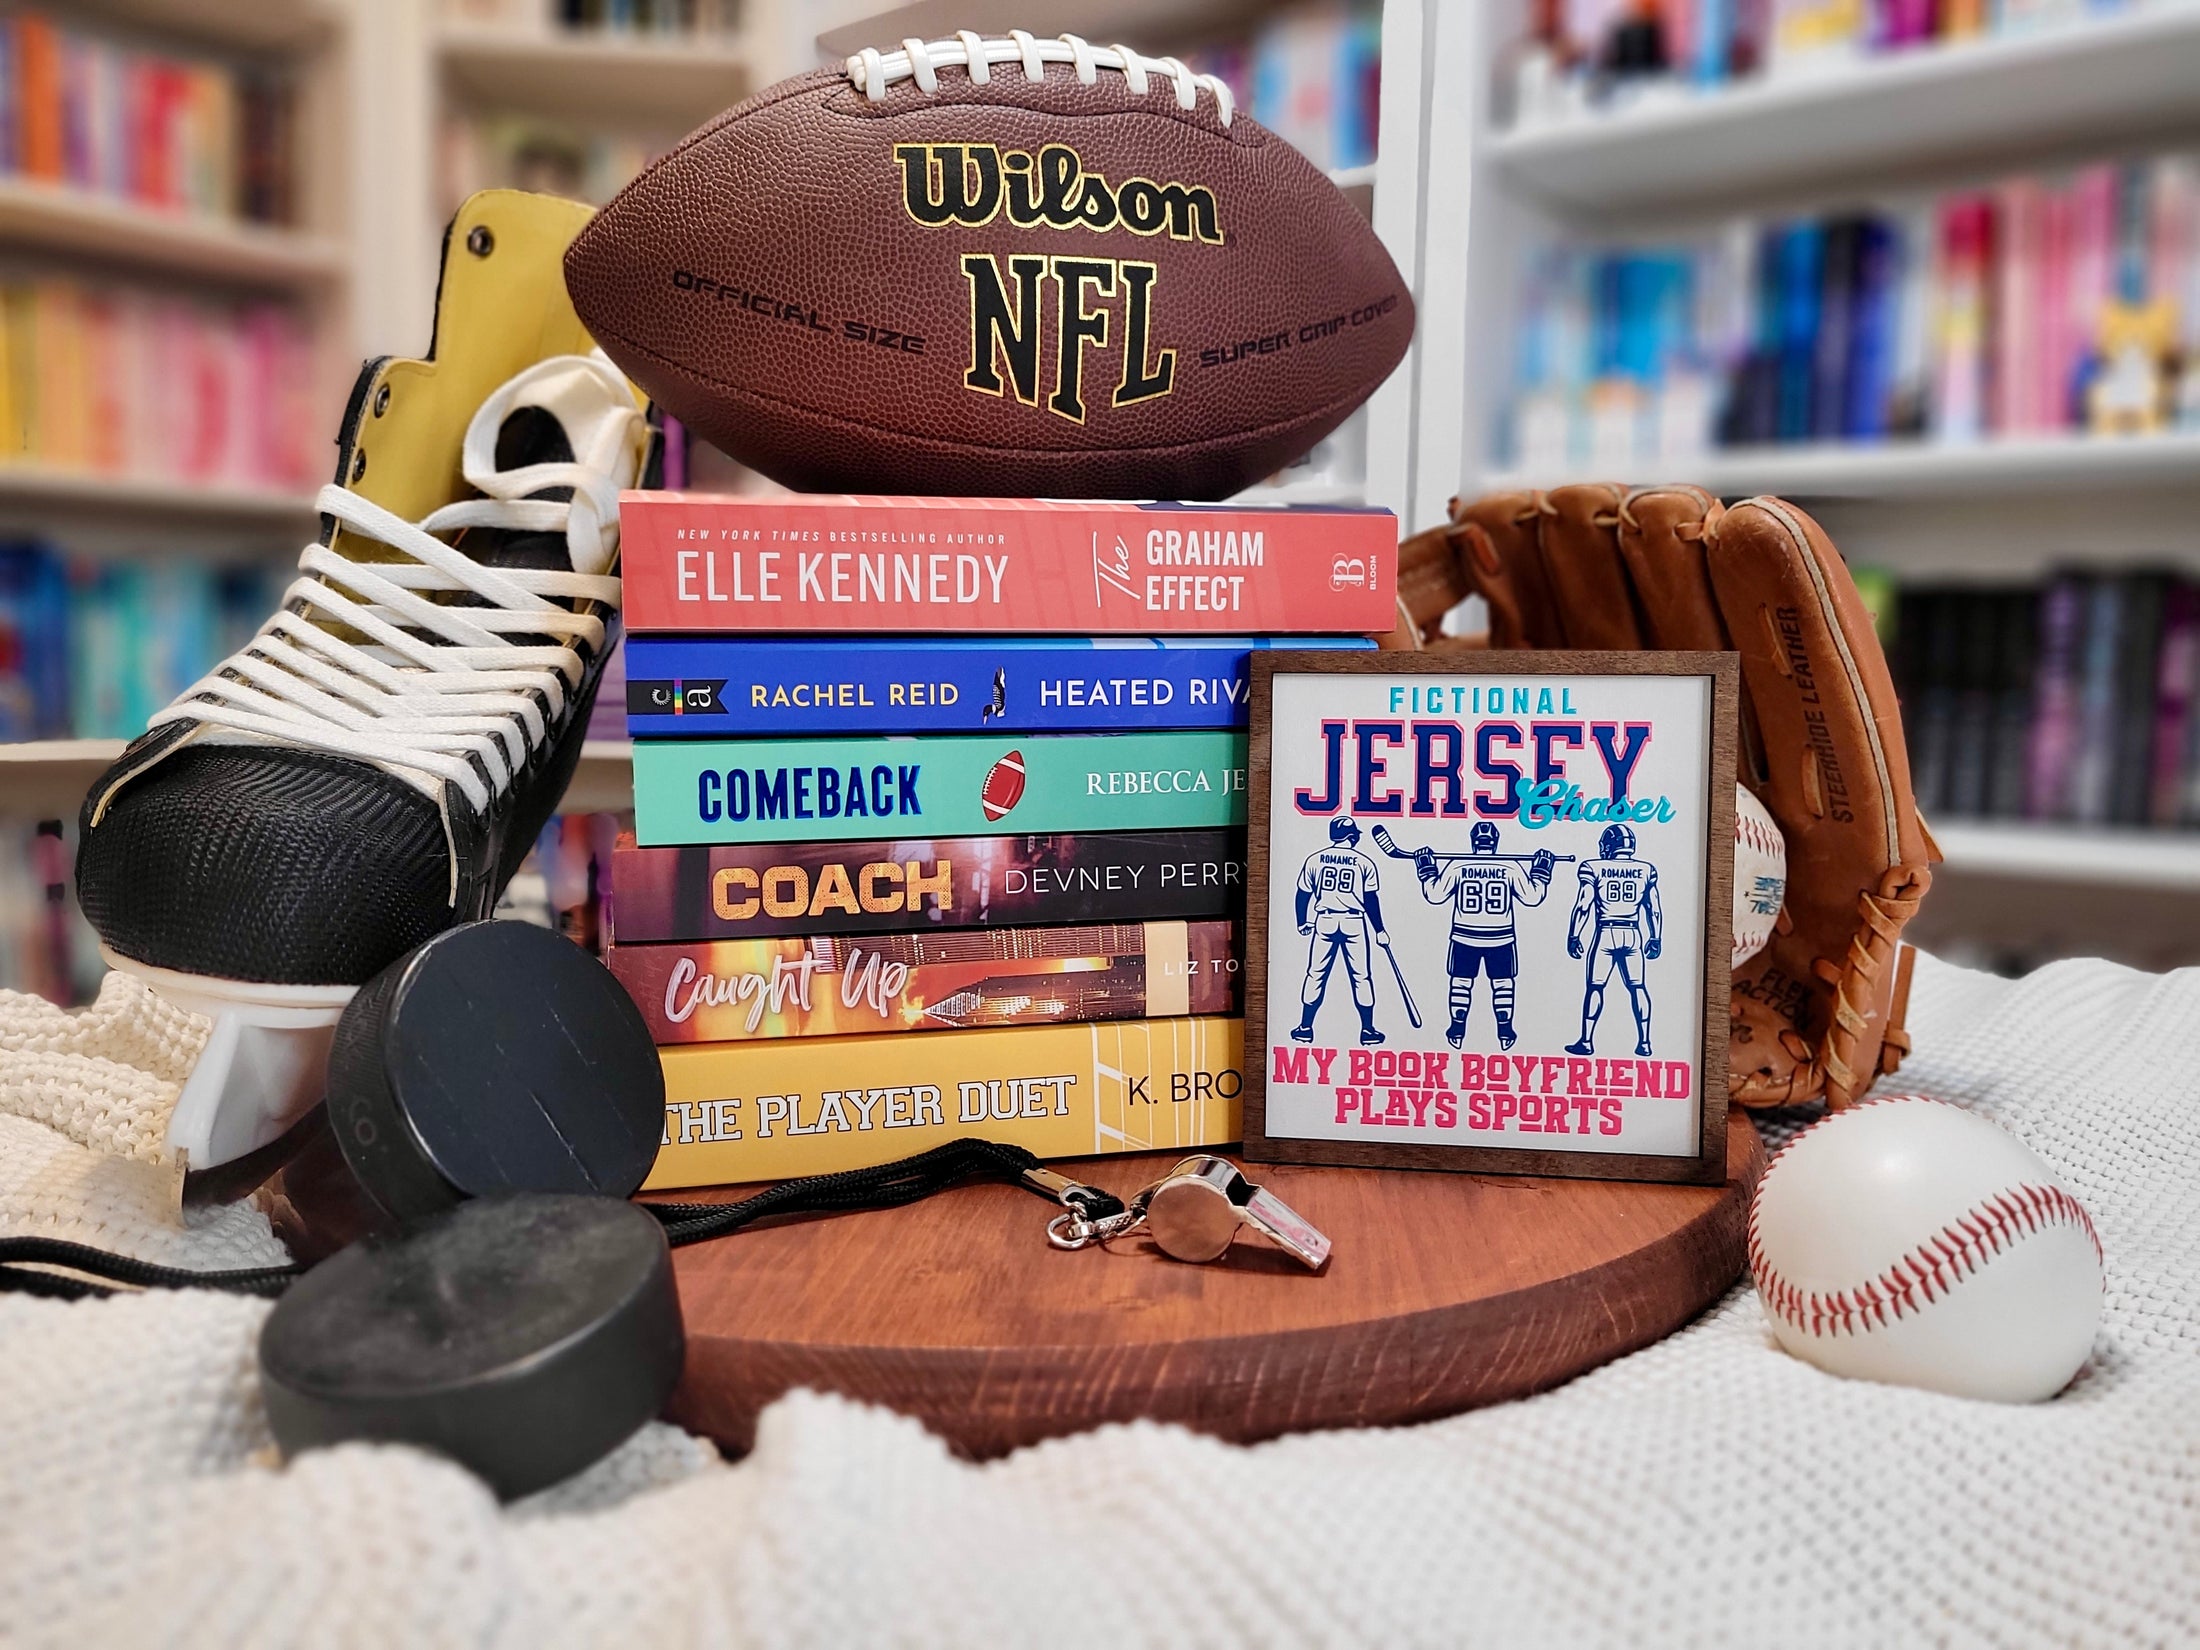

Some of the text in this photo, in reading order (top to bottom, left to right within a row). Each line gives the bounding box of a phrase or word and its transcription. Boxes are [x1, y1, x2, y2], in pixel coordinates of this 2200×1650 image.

[893, 142, 1225, 245] Wilson
[672, 269, 927, 355] OFFICIAL SIZE
[959, 254, 1177, 426] NFL
[1199, 331, 1291, 368] SUPER
[1299, 316, 1346, 343] GRIP
[677, 528, 1006, 545] NEW YORK TIMES BESTSELLING AUTHOR
[1146, 529, 1264, 567] GRAHAM
[677, 550, 1009, 604] ELLE KENNEDY
[1092, 531, 1142, 608] The
[1369, 555, 1377, 591] BLOOM
[1146, 575, 1245, 611] EFFECT
[751, 683, 959, 708] RACHEL REID
[1040, 678, 1175, 707] HEATED
[1388, 686, 1578, 715] FICTIONAL
[1776, 606, 1854, 824] STEERHIDE LEATHER
[1086, 769, 1212, 796] REBECCA
[1293, 719, 1653, 819] JERSEY
[698, 764, 923, 823] COMEBACK
[1515, 778, 1677, 830] Chaser
[1005, 861, 1248, 895] DEVNEY PERR
[1319, 853, 1358, 867] ROMANCE
[1461, 867, 1507, 880] ROMANCE
[1602, 868, 1643, 880] ROMANCE
[712, 860, 952, 921] COACH
[1320, 866, 1355, 893] 69
[1460, 880, 1507, 915] 69
[1606, 881, 1637, 902] 69
[1164, 959, 1246, 976] LIZ TO
[664, 950, 835, 1033] Caught
[841, 948, 910, 1018] Up
[1128, 1068, 1244, 1106] K. BRO
[1272, 1045, 1691, 1100] MY BOOK BOYFRIEND
[756, 1084, 944, 1139] PLAYER
[958, 1075, 1077, 1124] DUET
[1335, 1087, 1623, 1137] PLAYS SPORTS
